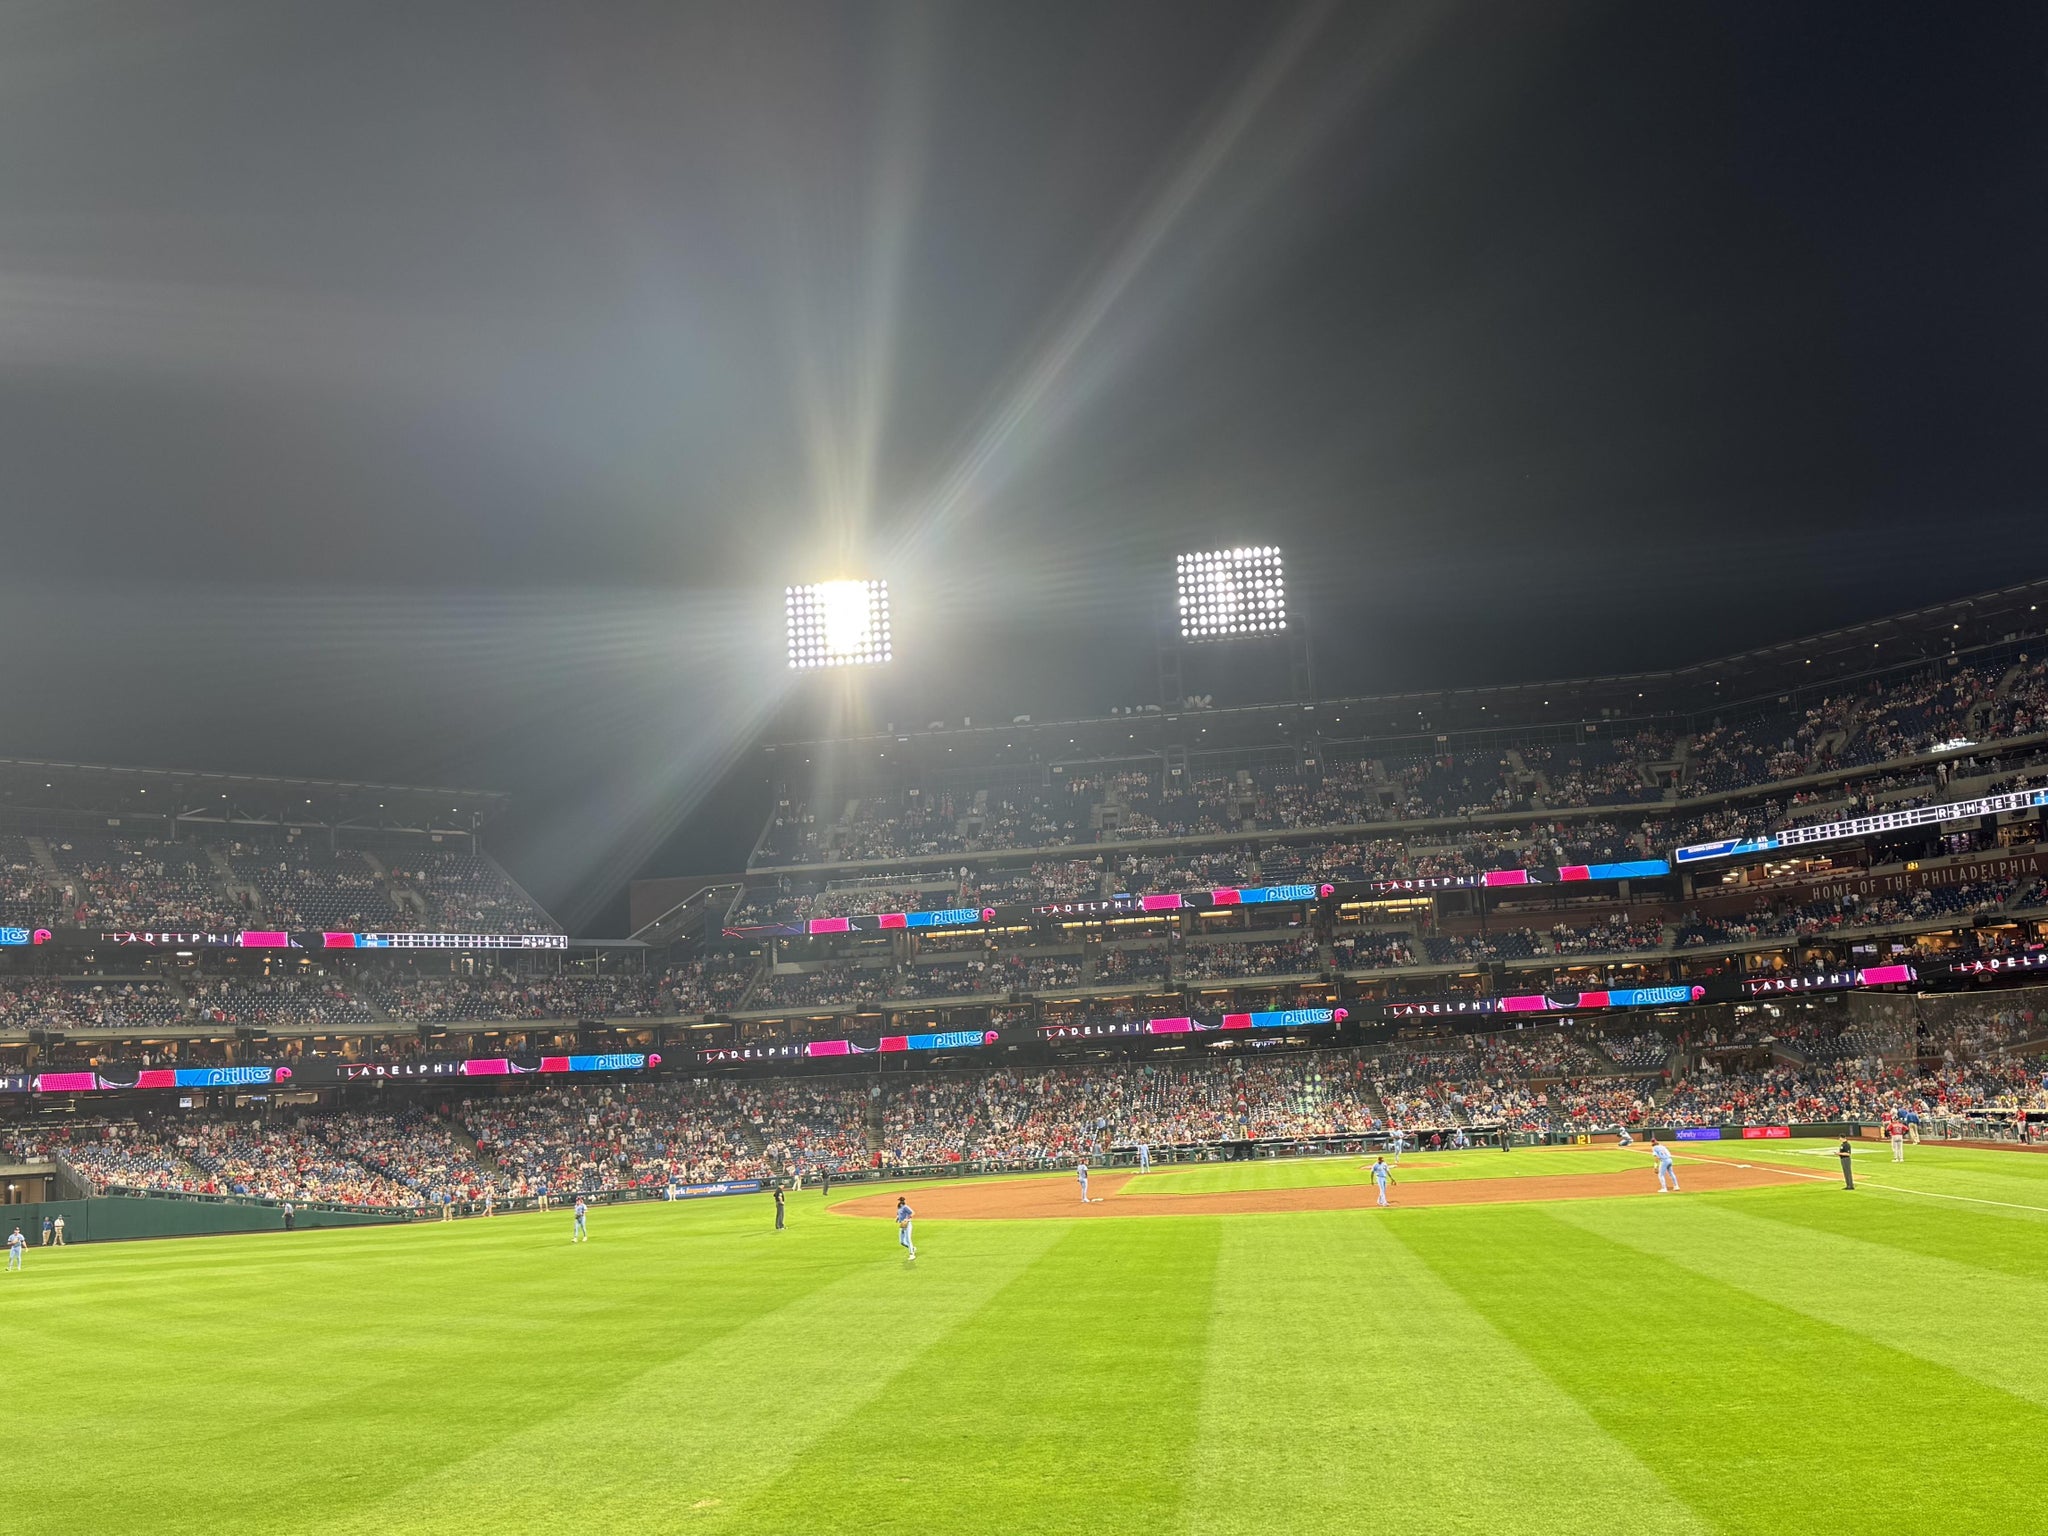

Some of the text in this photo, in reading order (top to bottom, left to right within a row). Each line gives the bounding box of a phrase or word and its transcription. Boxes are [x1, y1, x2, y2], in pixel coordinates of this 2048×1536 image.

[1938, 798, 2003, 818] R H E
[1812, 857, 2039, 900] HOME OF THE PHILADELPHIA
[1576, 1136, 1592, 1144] 121
[1676, 1130, 1696, 1140] xfinity
